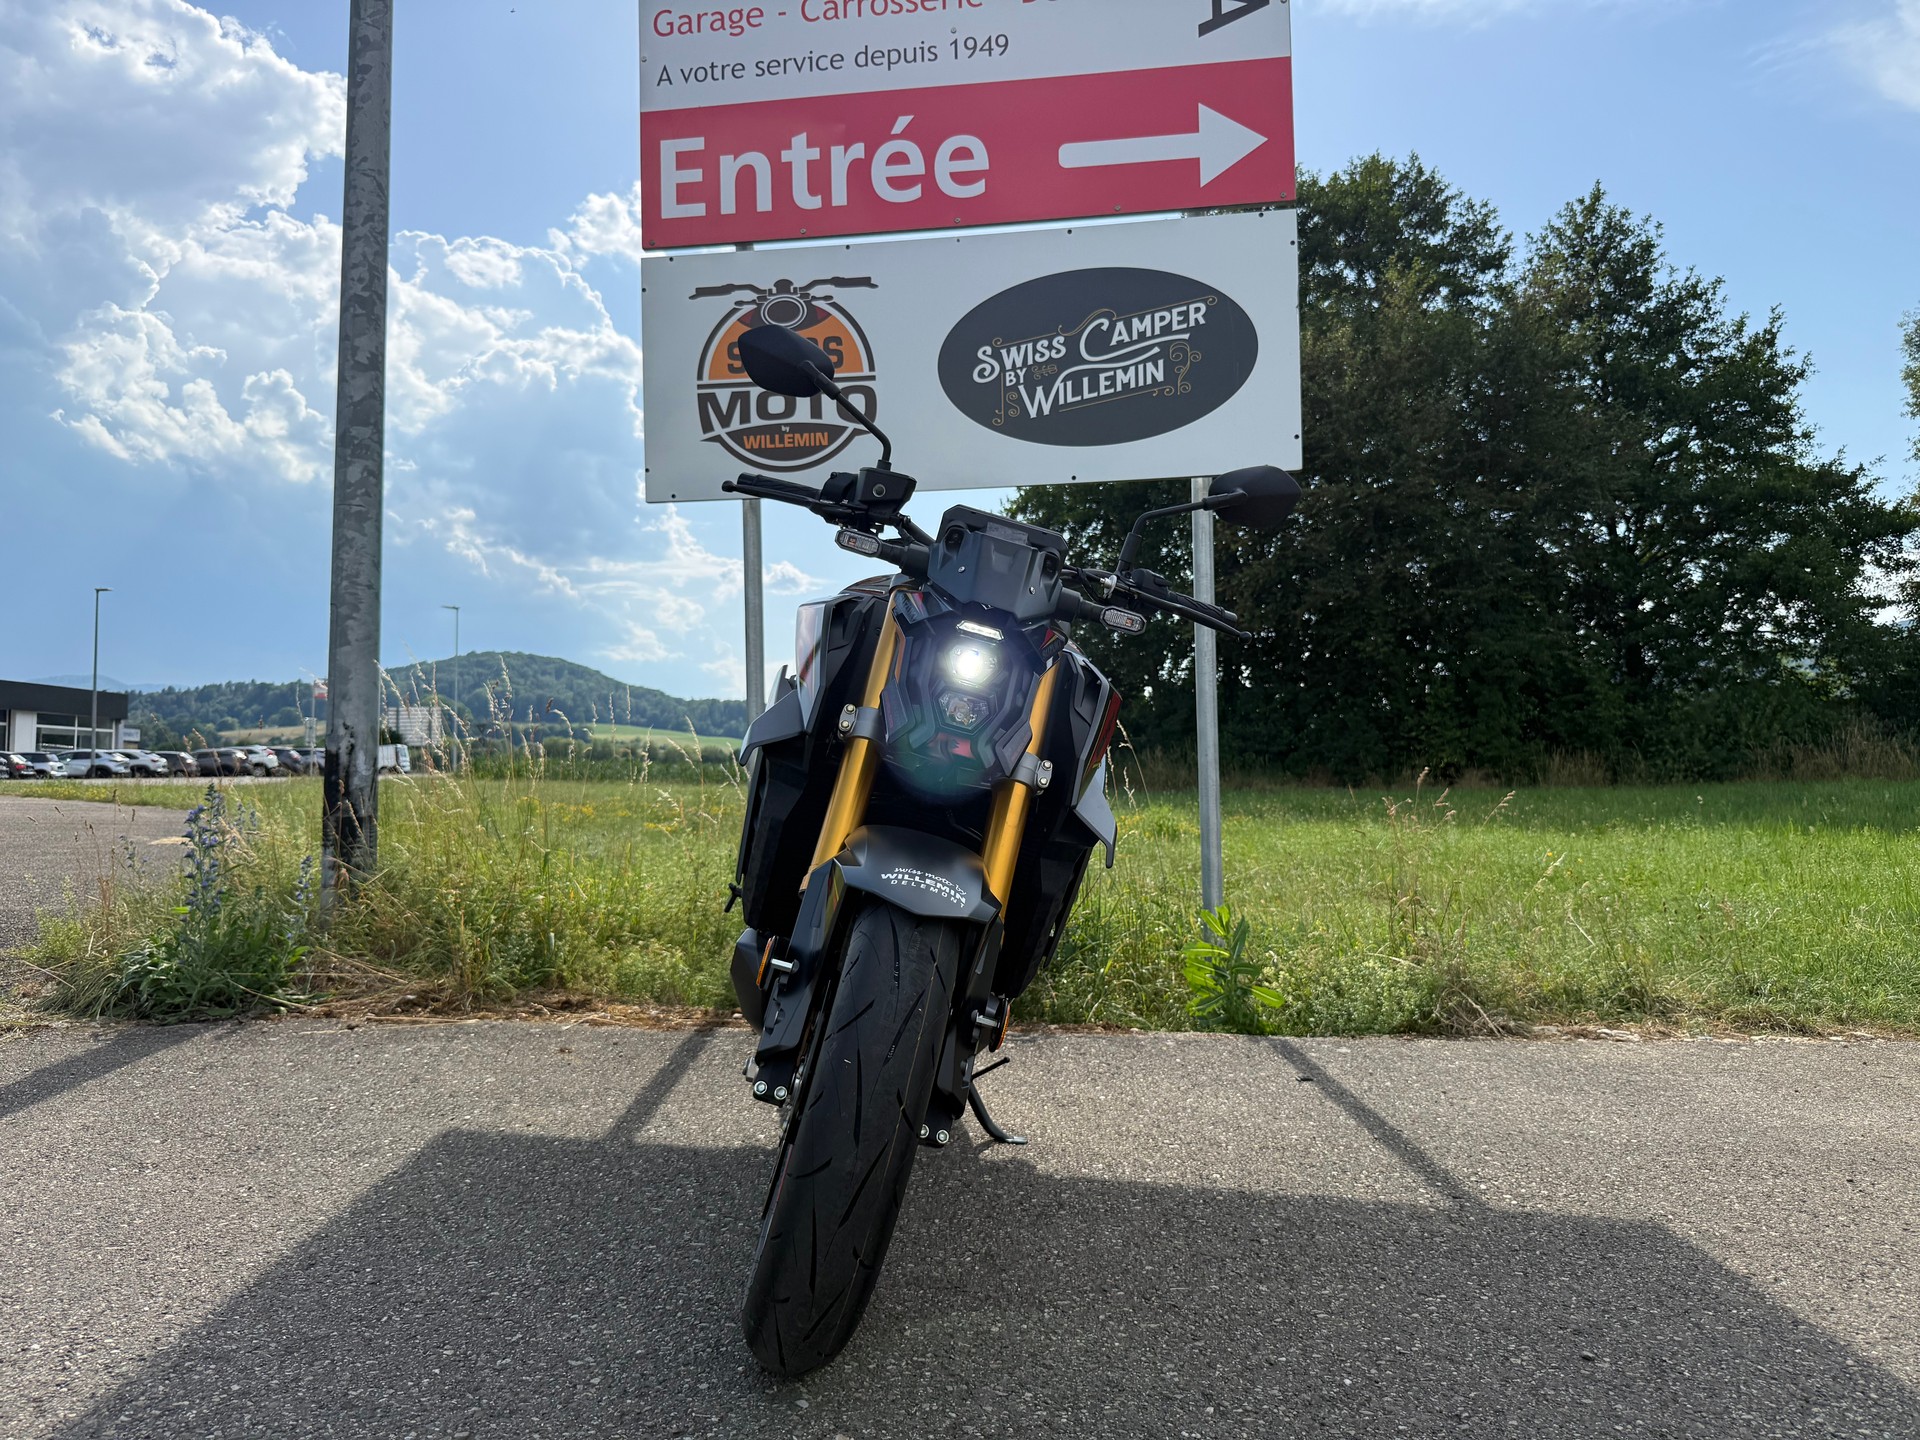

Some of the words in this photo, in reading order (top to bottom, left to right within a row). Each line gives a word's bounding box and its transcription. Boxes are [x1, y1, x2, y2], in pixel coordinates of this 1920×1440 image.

[653, 7, 765, 37] Garage
[656, 64, 673, 87] A
[680, 62, 746, 84] votre
[755, 51, 842, 77] service
[854, 40, 939, 71] depuis
[949, 33, 1009, 60] 1949
[659, 114, 990, 219] Entrée
[972, 335, 1067, 384] SWISS
[1079, 302, 1207, 362] CAMPER
[1005, 367, 1028, 387] BY
[1017, 346, 1165, 419] WILLEMIN
[743, 432, 829, 450] WILLEMIN
[781, 424, 790, 433] by
[881, 873, 966, 904] WILLEMIN
[891, 879, 965, 908] DELEMONT
[925, 872, 955, 887] moto
[955, 883, 967, 895] by
